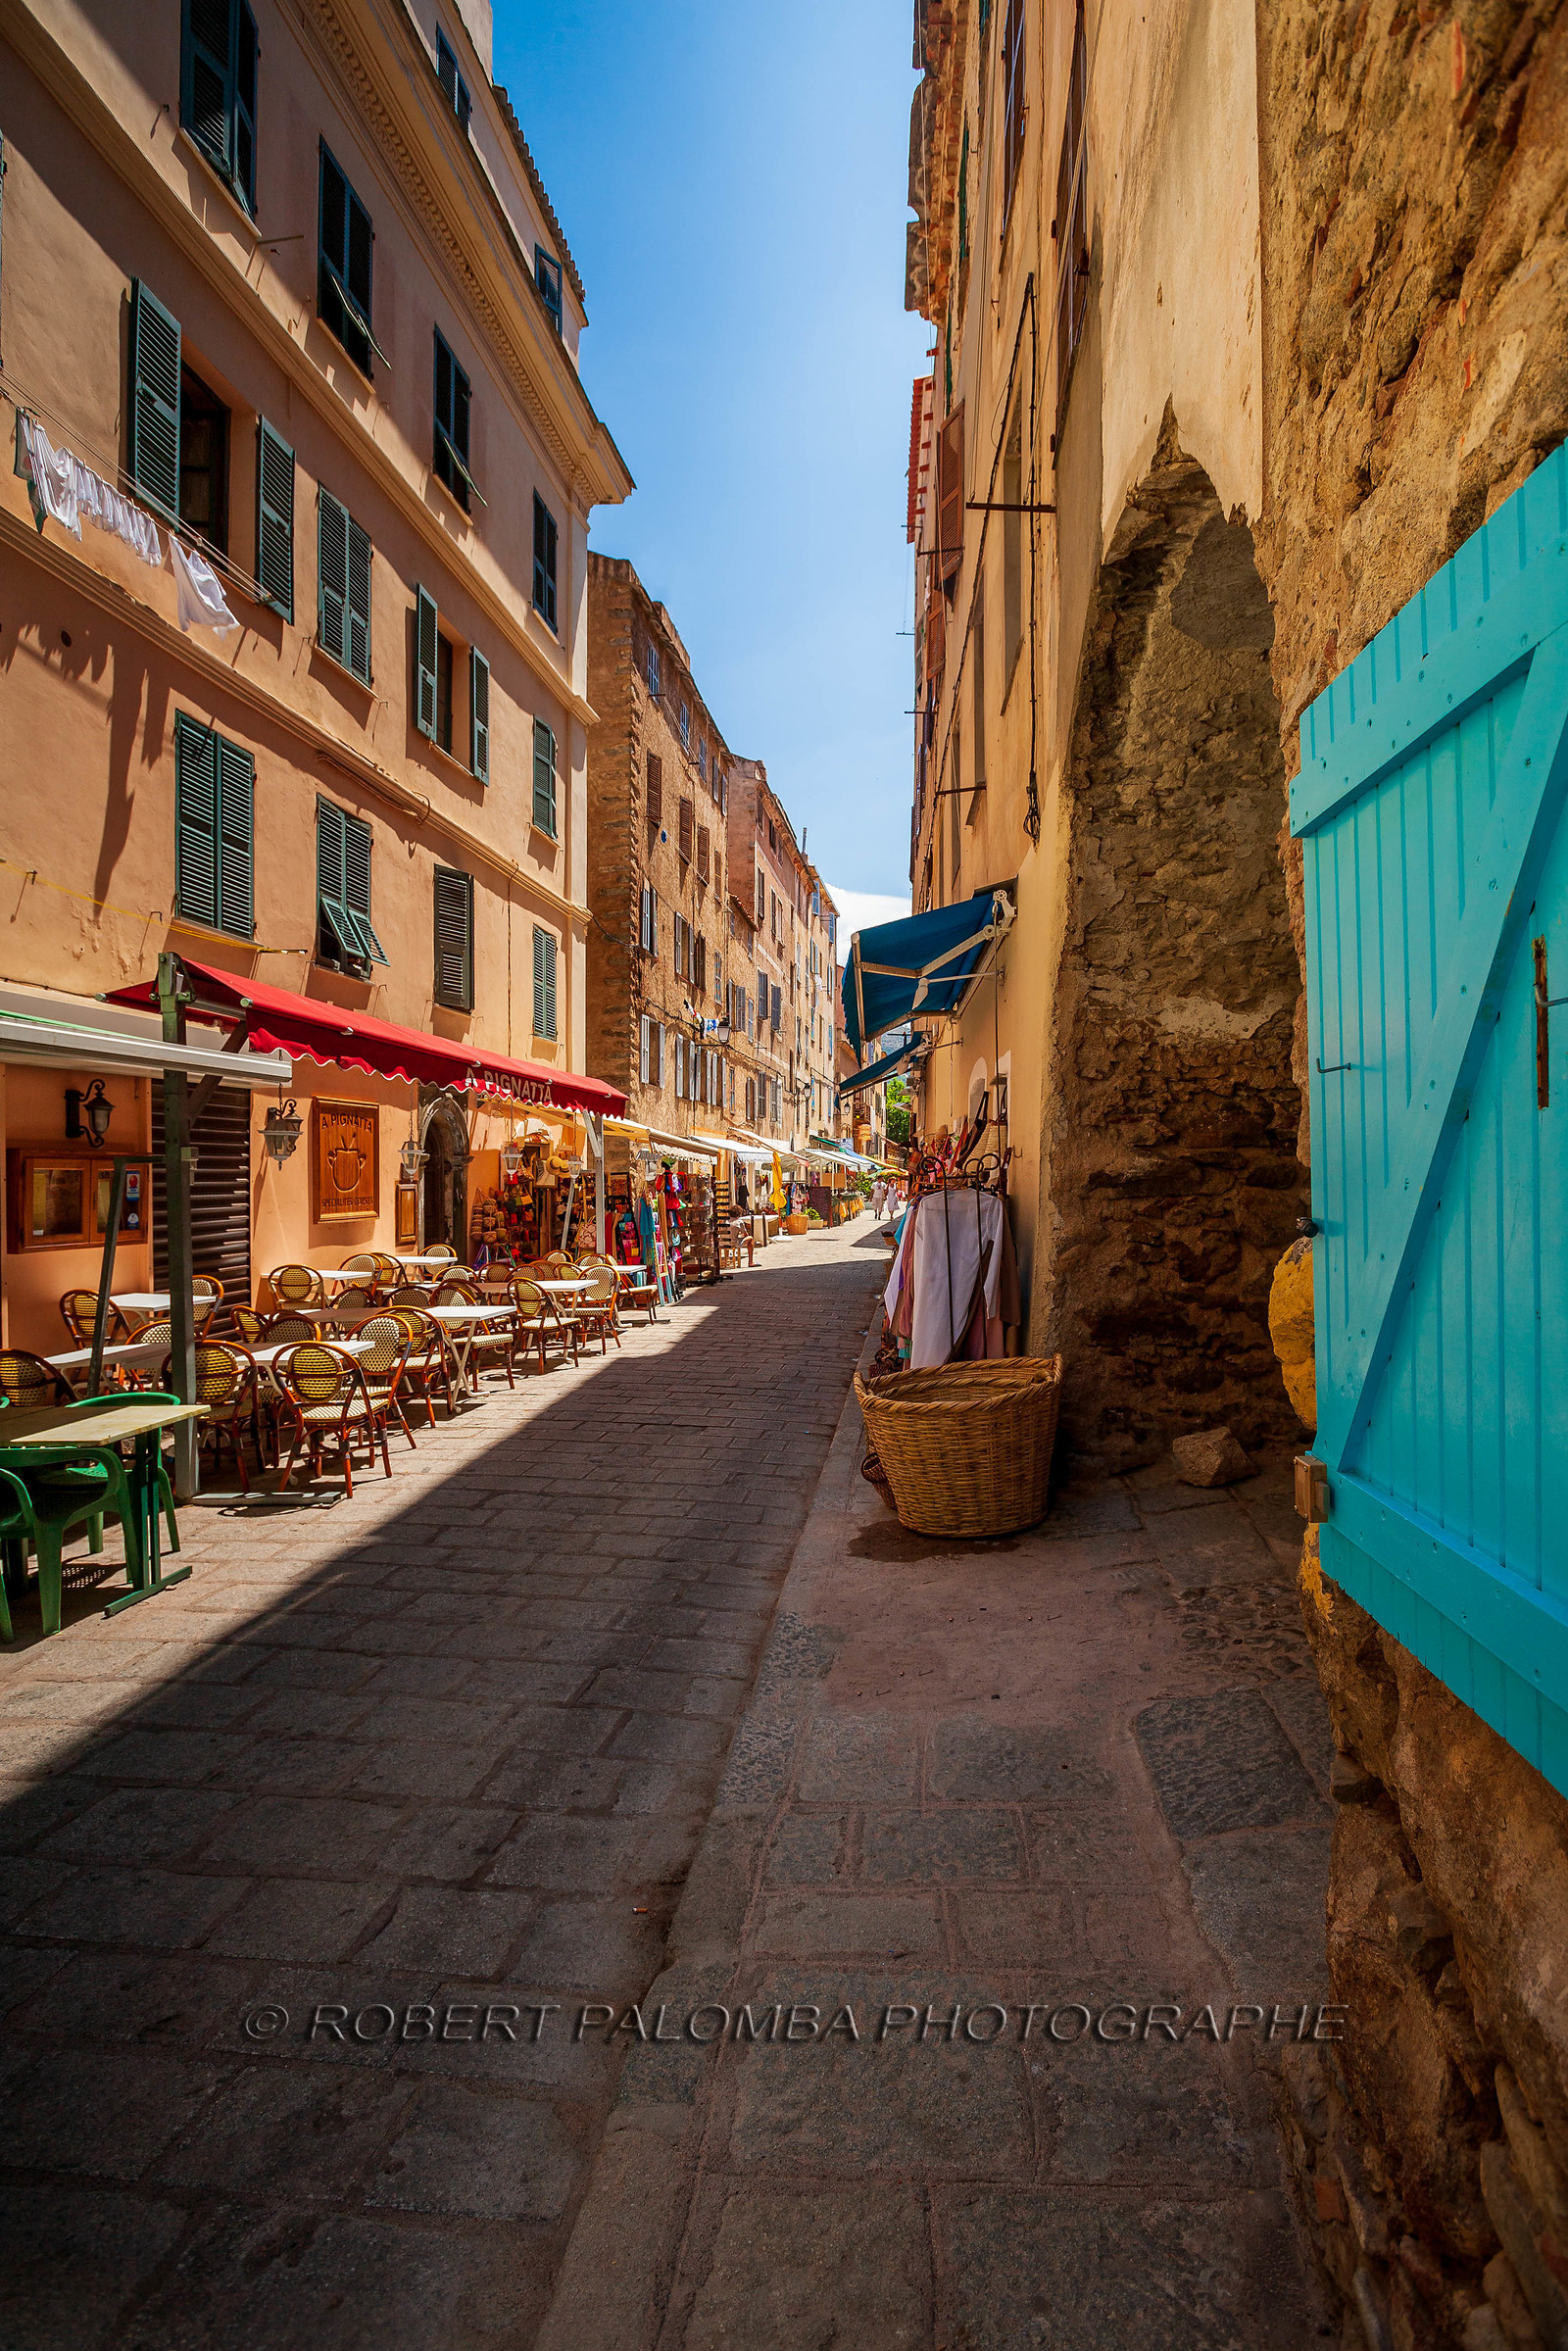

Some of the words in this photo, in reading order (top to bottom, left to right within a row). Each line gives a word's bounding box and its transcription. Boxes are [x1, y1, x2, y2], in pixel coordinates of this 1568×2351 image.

[465, 1067, 478, 1088] A
[484, 1070, 553, 1102] PIGNATTA
[321, 1116, 328, 1129] A
[330, 1112, 372, 1133] PIGNATTA
